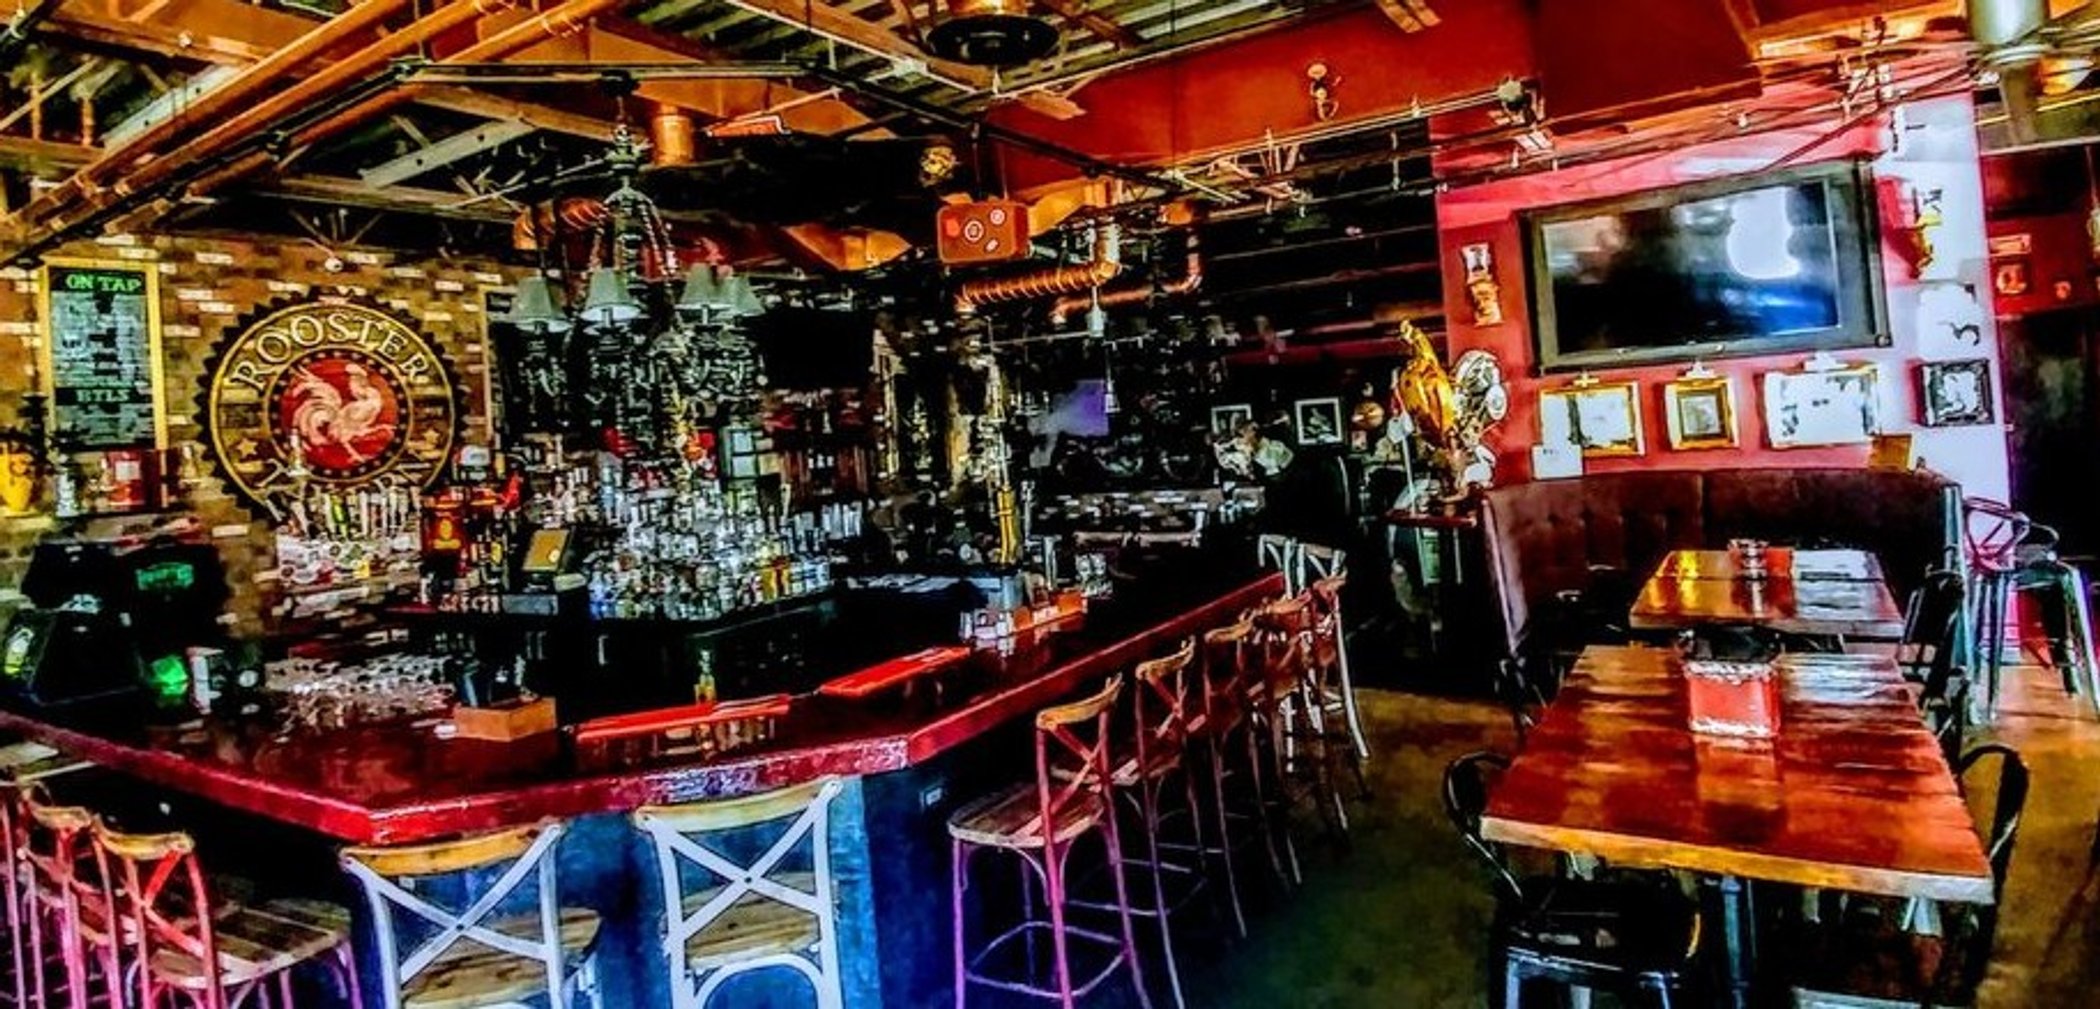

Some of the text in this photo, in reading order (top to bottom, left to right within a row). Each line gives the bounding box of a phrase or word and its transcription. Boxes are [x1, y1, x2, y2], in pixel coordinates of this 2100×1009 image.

[65, 273, 141, 292] ON TAP
[229, 311, 430, 391] ROOSTER
[76, 388, 131, 402] BTLS
